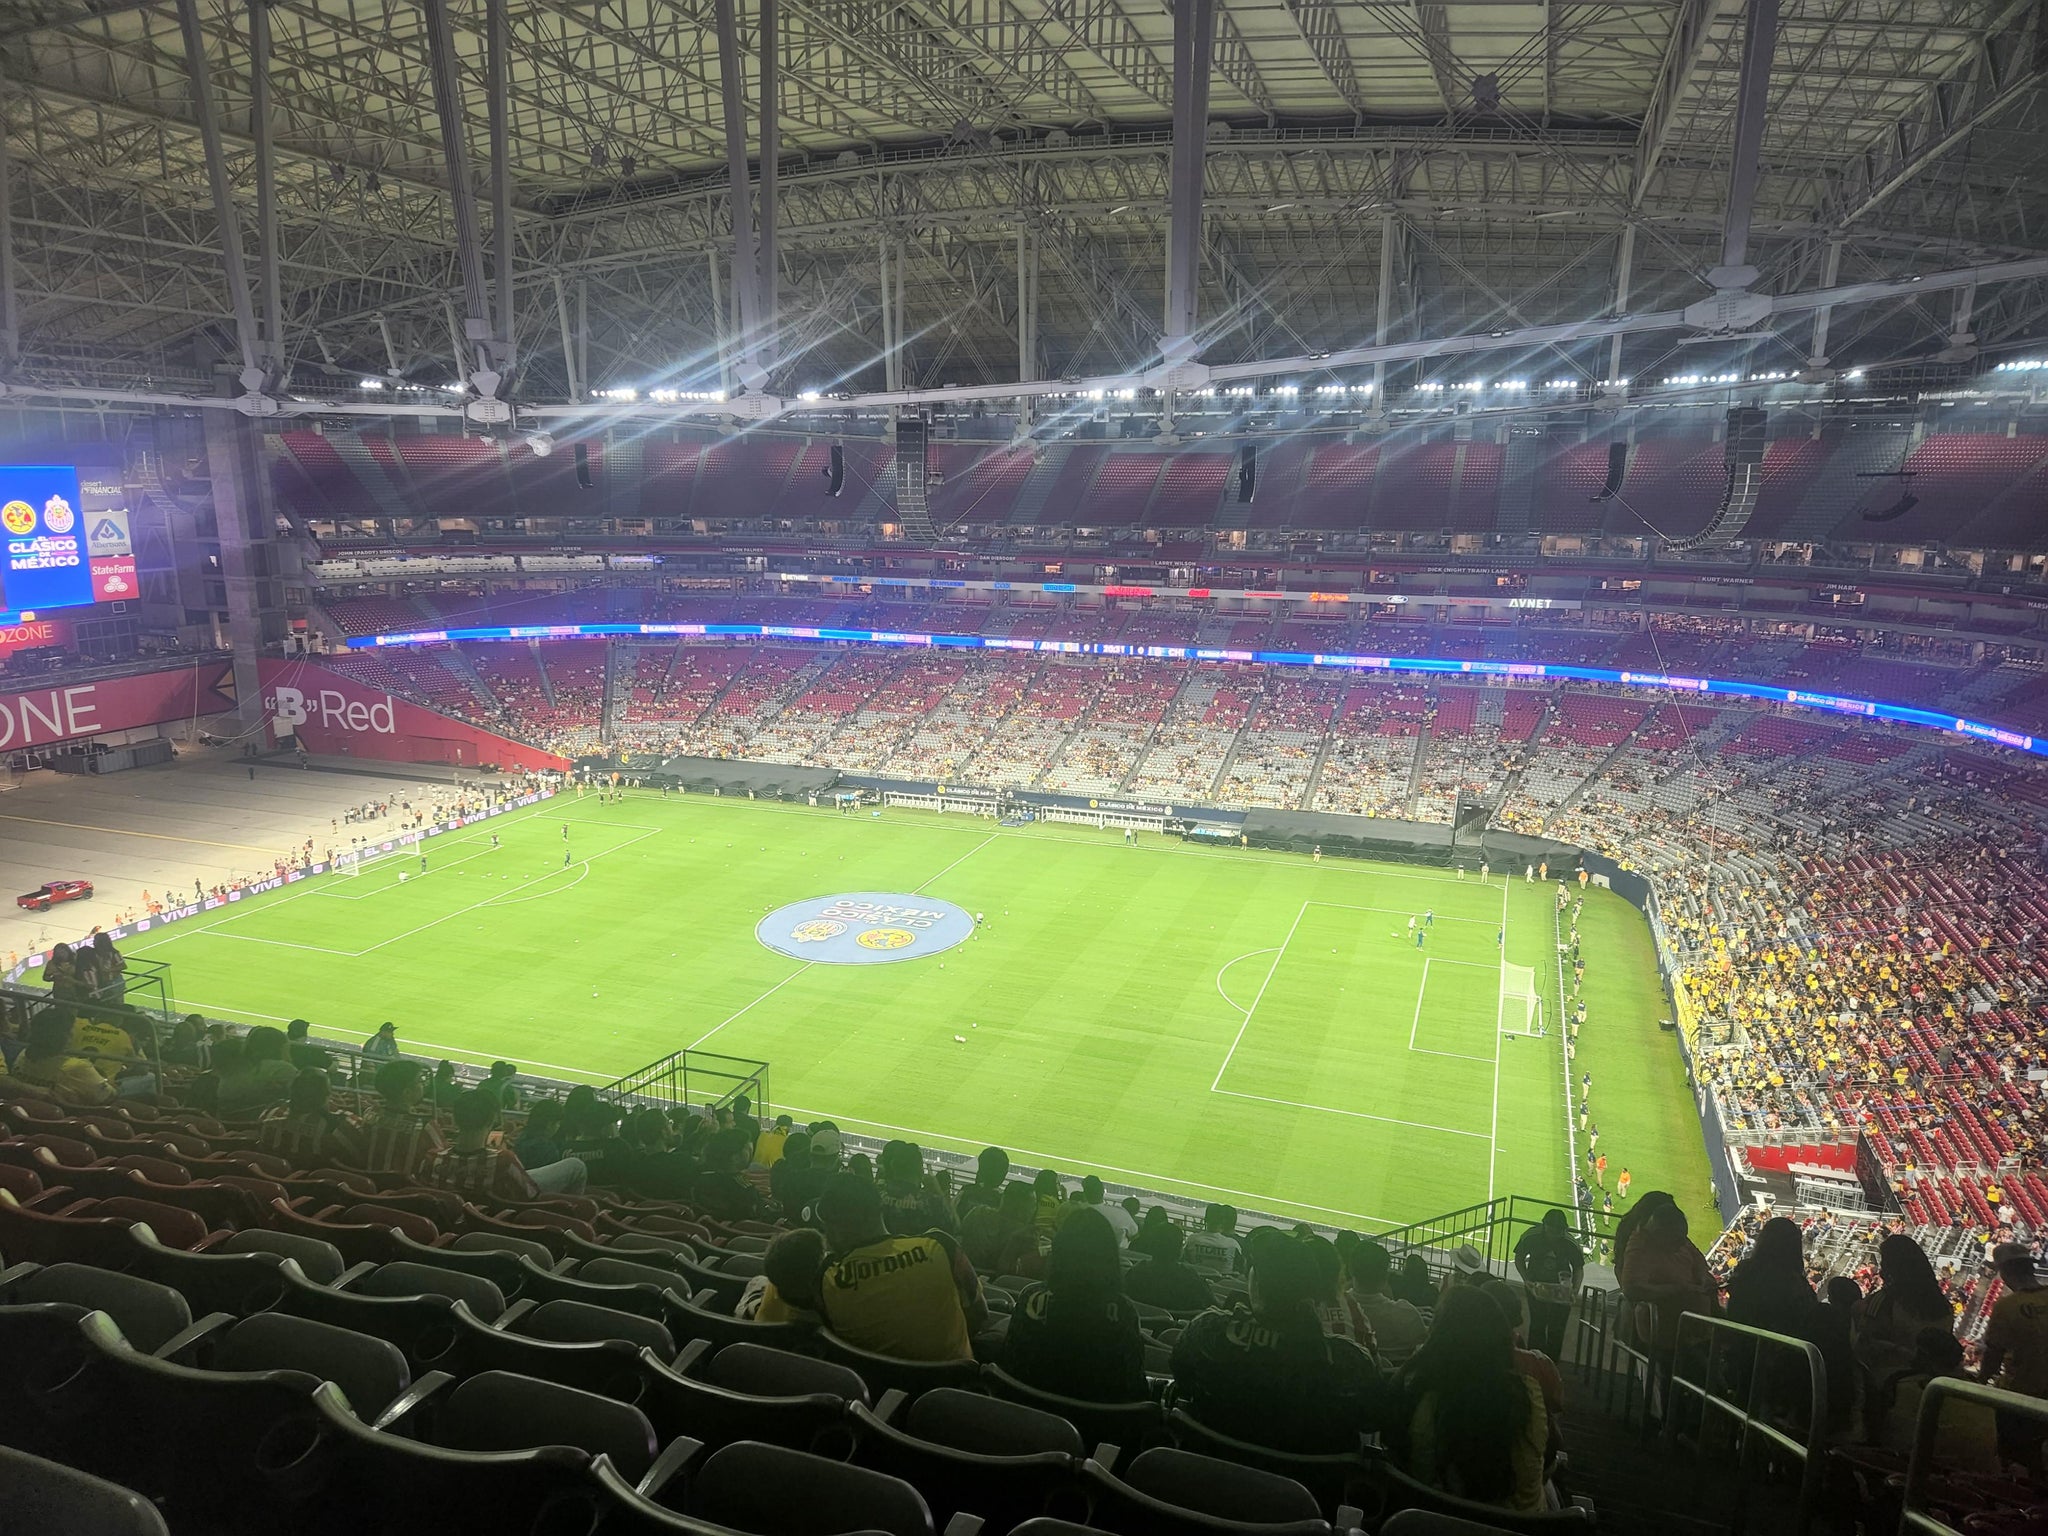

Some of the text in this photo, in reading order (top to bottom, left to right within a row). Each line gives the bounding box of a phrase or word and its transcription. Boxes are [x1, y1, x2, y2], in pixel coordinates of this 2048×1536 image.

[11, 556, 80, 570] MÉXICO
[1509, 598, 1552, 609] AVNET
[518, 794, 538, 807] VIVE
[463, 806, 502, 825] VIVE EL
[428, 827, 442, 836] EL
[364, 846, 379, 858] EL
[249, 872, 305, 894] VIVE EL
[160, 897, 224, 923] VIVE EL
[107, 929, 127, 942] EL
[834, 1245, 929, 1291] Corona
